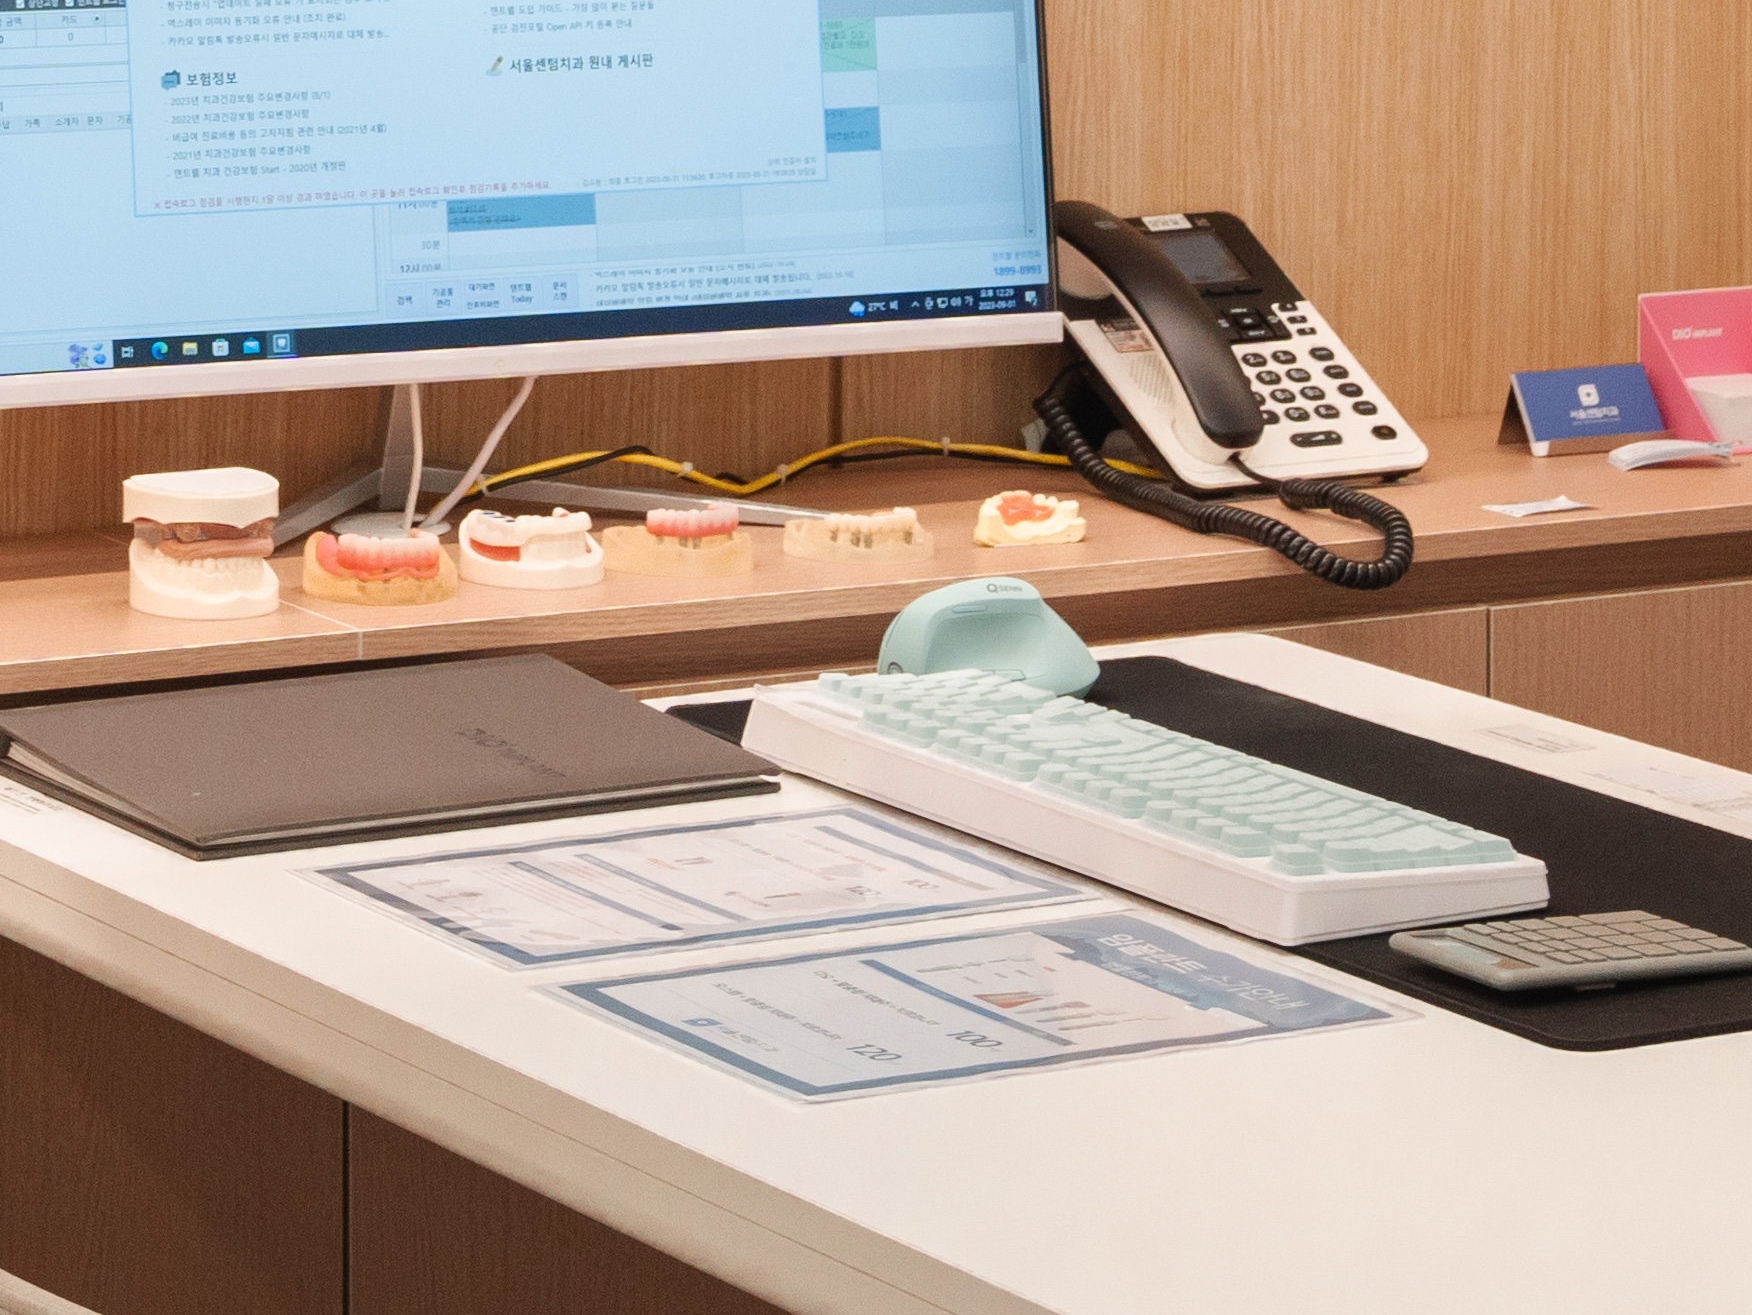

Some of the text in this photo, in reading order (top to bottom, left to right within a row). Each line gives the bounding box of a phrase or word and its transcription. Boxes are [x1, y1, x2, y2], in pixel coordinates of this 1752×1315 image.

[510, 54, 654, 73] 서울센텀치과 원내 게시판
[186, 72, 238, 86] 보험정보
[170, 96, 199, 107] 2023년
[997, 288, 1014, 297] 12:29
[978, 300, 1016, 310] 2023-09-01
[1097, 932, 1208, 976] 임플란트
[845, 1043, 902, 1063] 120
